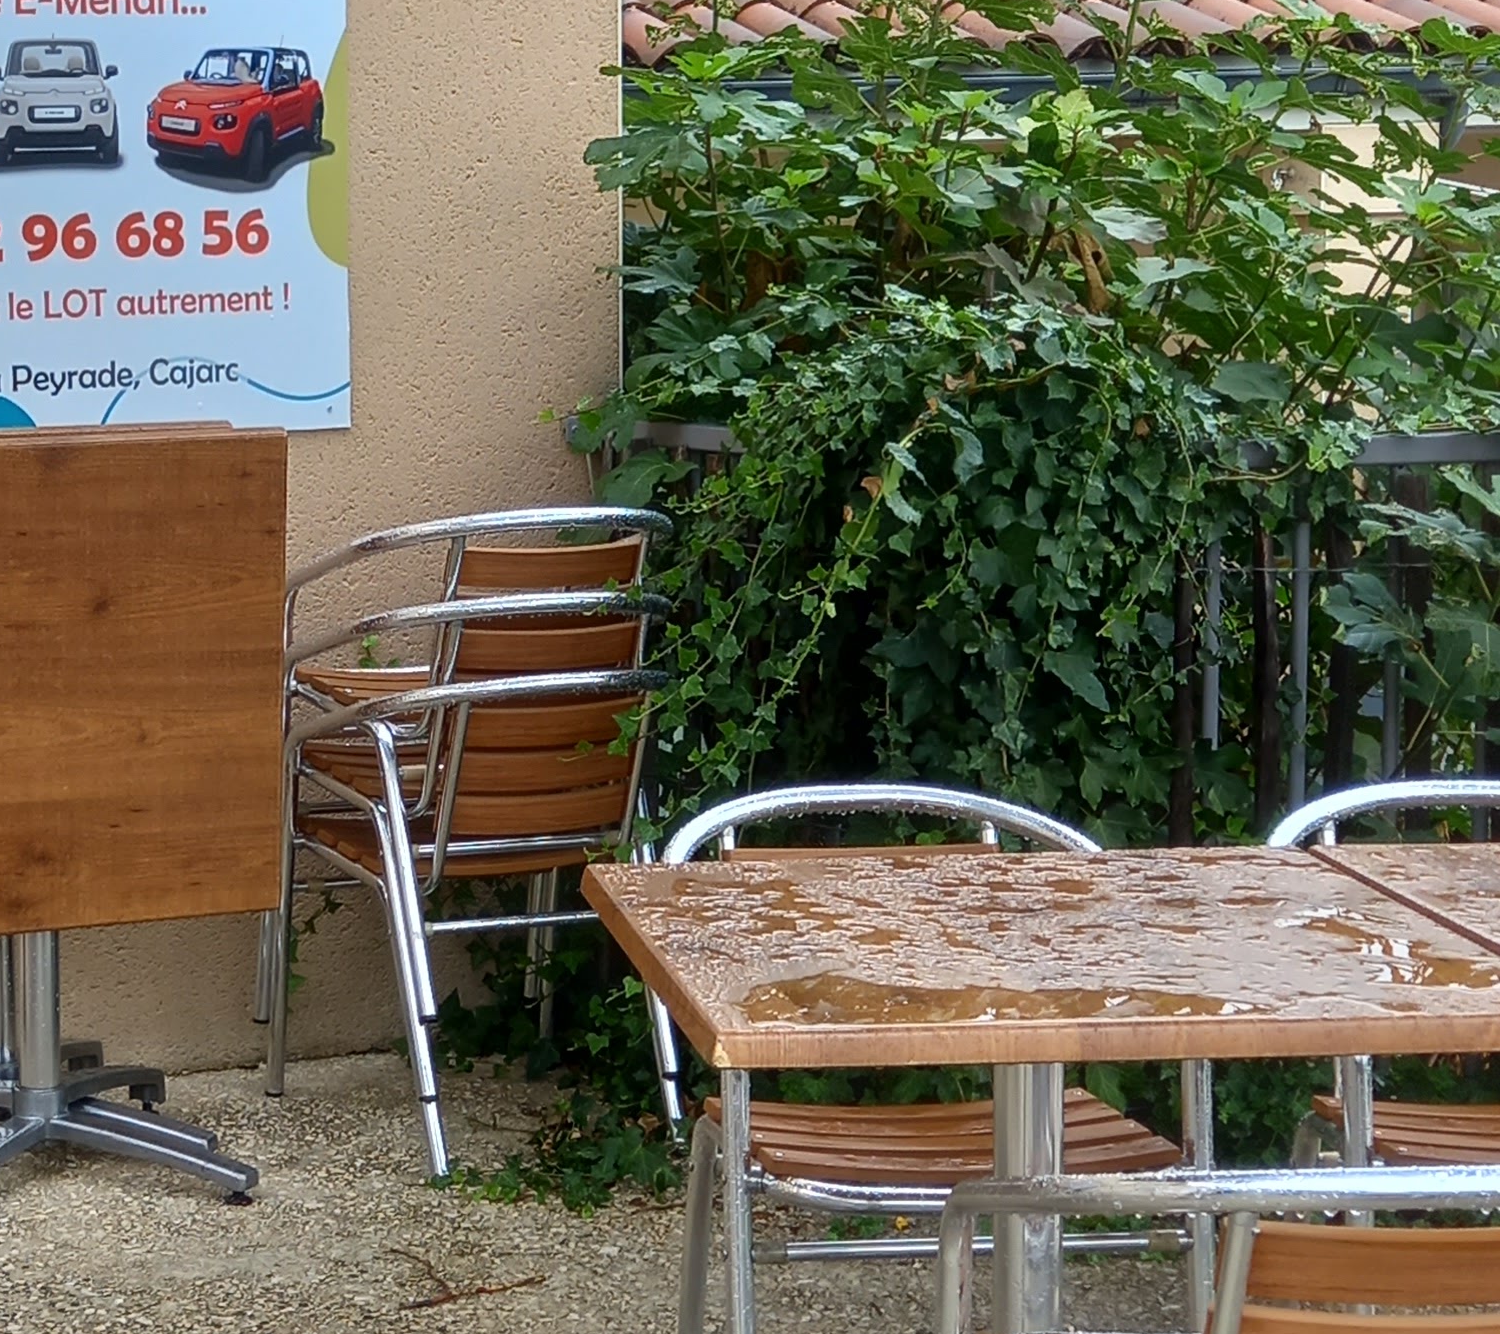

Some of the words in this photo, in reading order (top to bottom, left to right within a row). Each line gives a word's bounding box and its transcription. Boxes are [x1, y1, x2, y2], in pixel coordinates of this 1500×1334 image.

[21, 213, 97, 262] 96
[116, 211, 185, 258] 68
[202, 208, 270, 256] 56
[8, 292, 33, 320] le
[43, 289, 107, 319] LOT
[116, 286, 274, 316] autrement
[283, 283, 290, 310] !
[11, 360, 141, 396] Peyrade,
[150, 358, 239, 389] Cajarc
